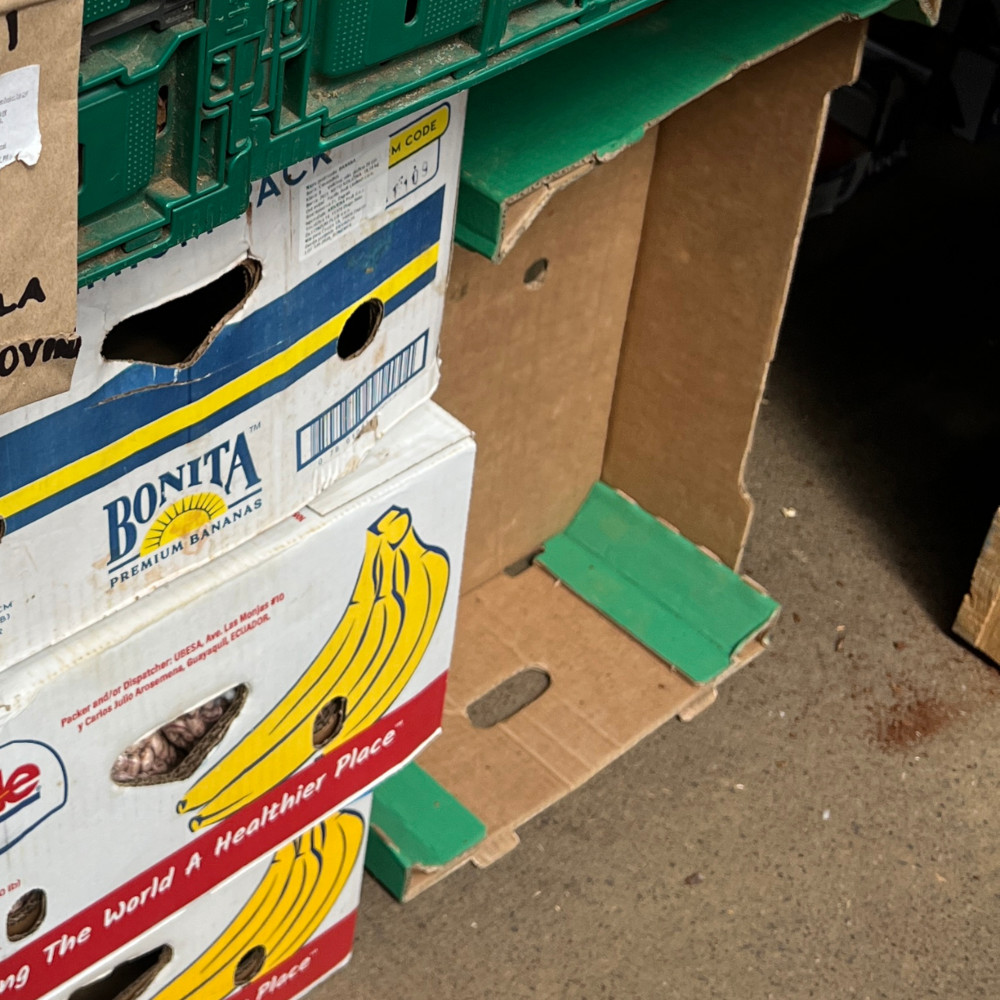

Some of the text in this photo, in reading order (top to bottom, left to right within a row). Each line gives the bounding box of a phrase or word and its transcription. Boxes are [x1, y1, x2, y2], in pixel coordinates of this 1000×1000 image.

[405, 119, 437, 147] CODE
[110, 498, 263, 589] PREMIUM BANANAS
[60, 593, 285, 728] Packer and/or Dispatcher: UBESA, Ave. Las Monjas #10
[77, 614, 271, 733] y Carlos Julio Arosemena, Guayaquil, ECUADOR.
[7, 879, 21, 893] lb)
[42, 925, 91, 964] The
[104, 868, 175, 925] World
[184, 854, 202, 877] A
[214, 777, 325, 858] Healthier
